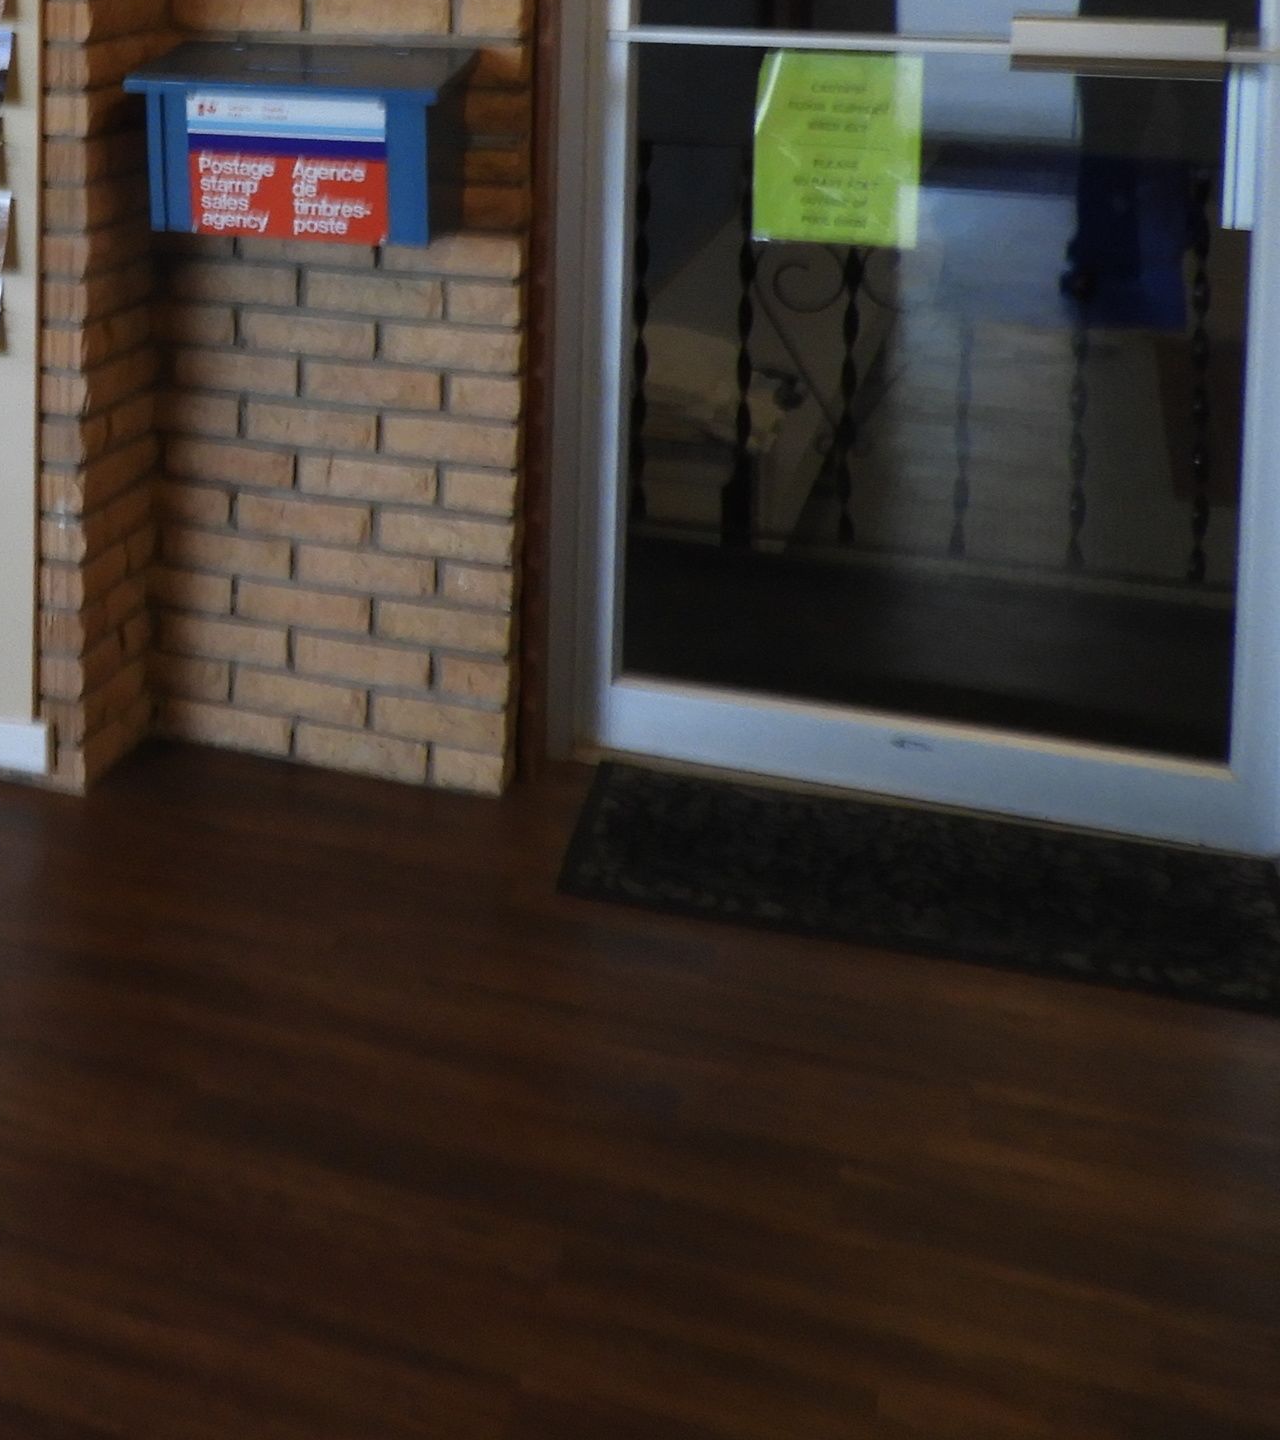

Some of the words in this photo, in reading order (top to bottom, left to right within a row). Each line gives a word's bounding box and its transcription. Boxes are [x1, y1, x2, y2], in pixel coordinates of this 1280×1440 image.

[198, 154, 276, 180] Postage
[292, 156, 367, 182] Agence
[200, 174, 259, 195] stamp
[292, 178, 317, 198] de
[201, 192, 250, 211] sales
[294, 197, 372, 219] timbres-
[202, 211, 269, 233] agency
[294, 216, 347, 236] poste
